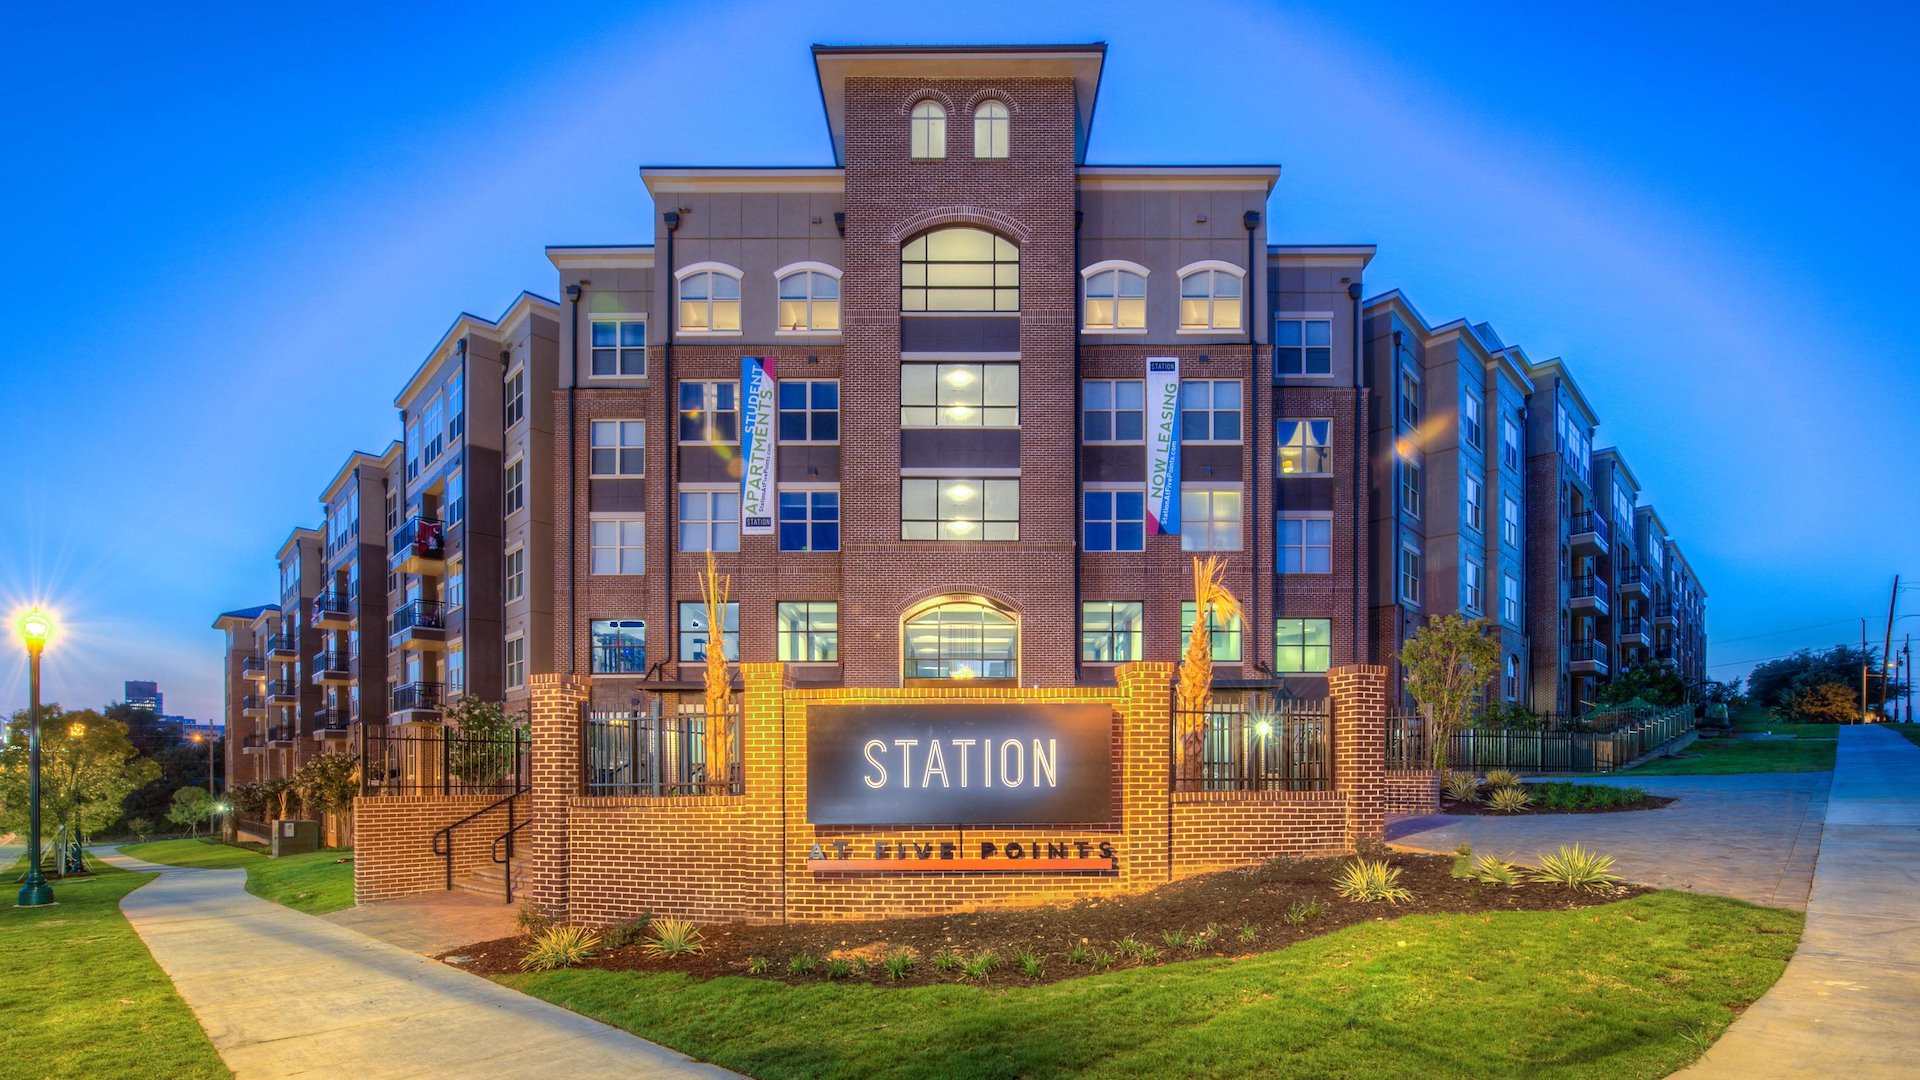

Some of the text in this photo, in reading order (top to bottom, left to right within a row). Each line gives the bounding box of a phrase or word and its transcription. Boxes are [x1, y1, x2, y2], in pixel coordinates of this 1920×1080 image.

[1151, 362, 1175, 371] STATION
[745, 365, 763, 434] STUDENT
[1156, 383, 1177, 453] LEASING
[745, 390, 773, 515] APARTMENTS
[1151, 458, 1167, 499] NOW
[746, 518, 771, 527] STATION
[864, 738, 1057, 789] STATION
[809, 841, 1112, 861] AT FIVE POINTS
